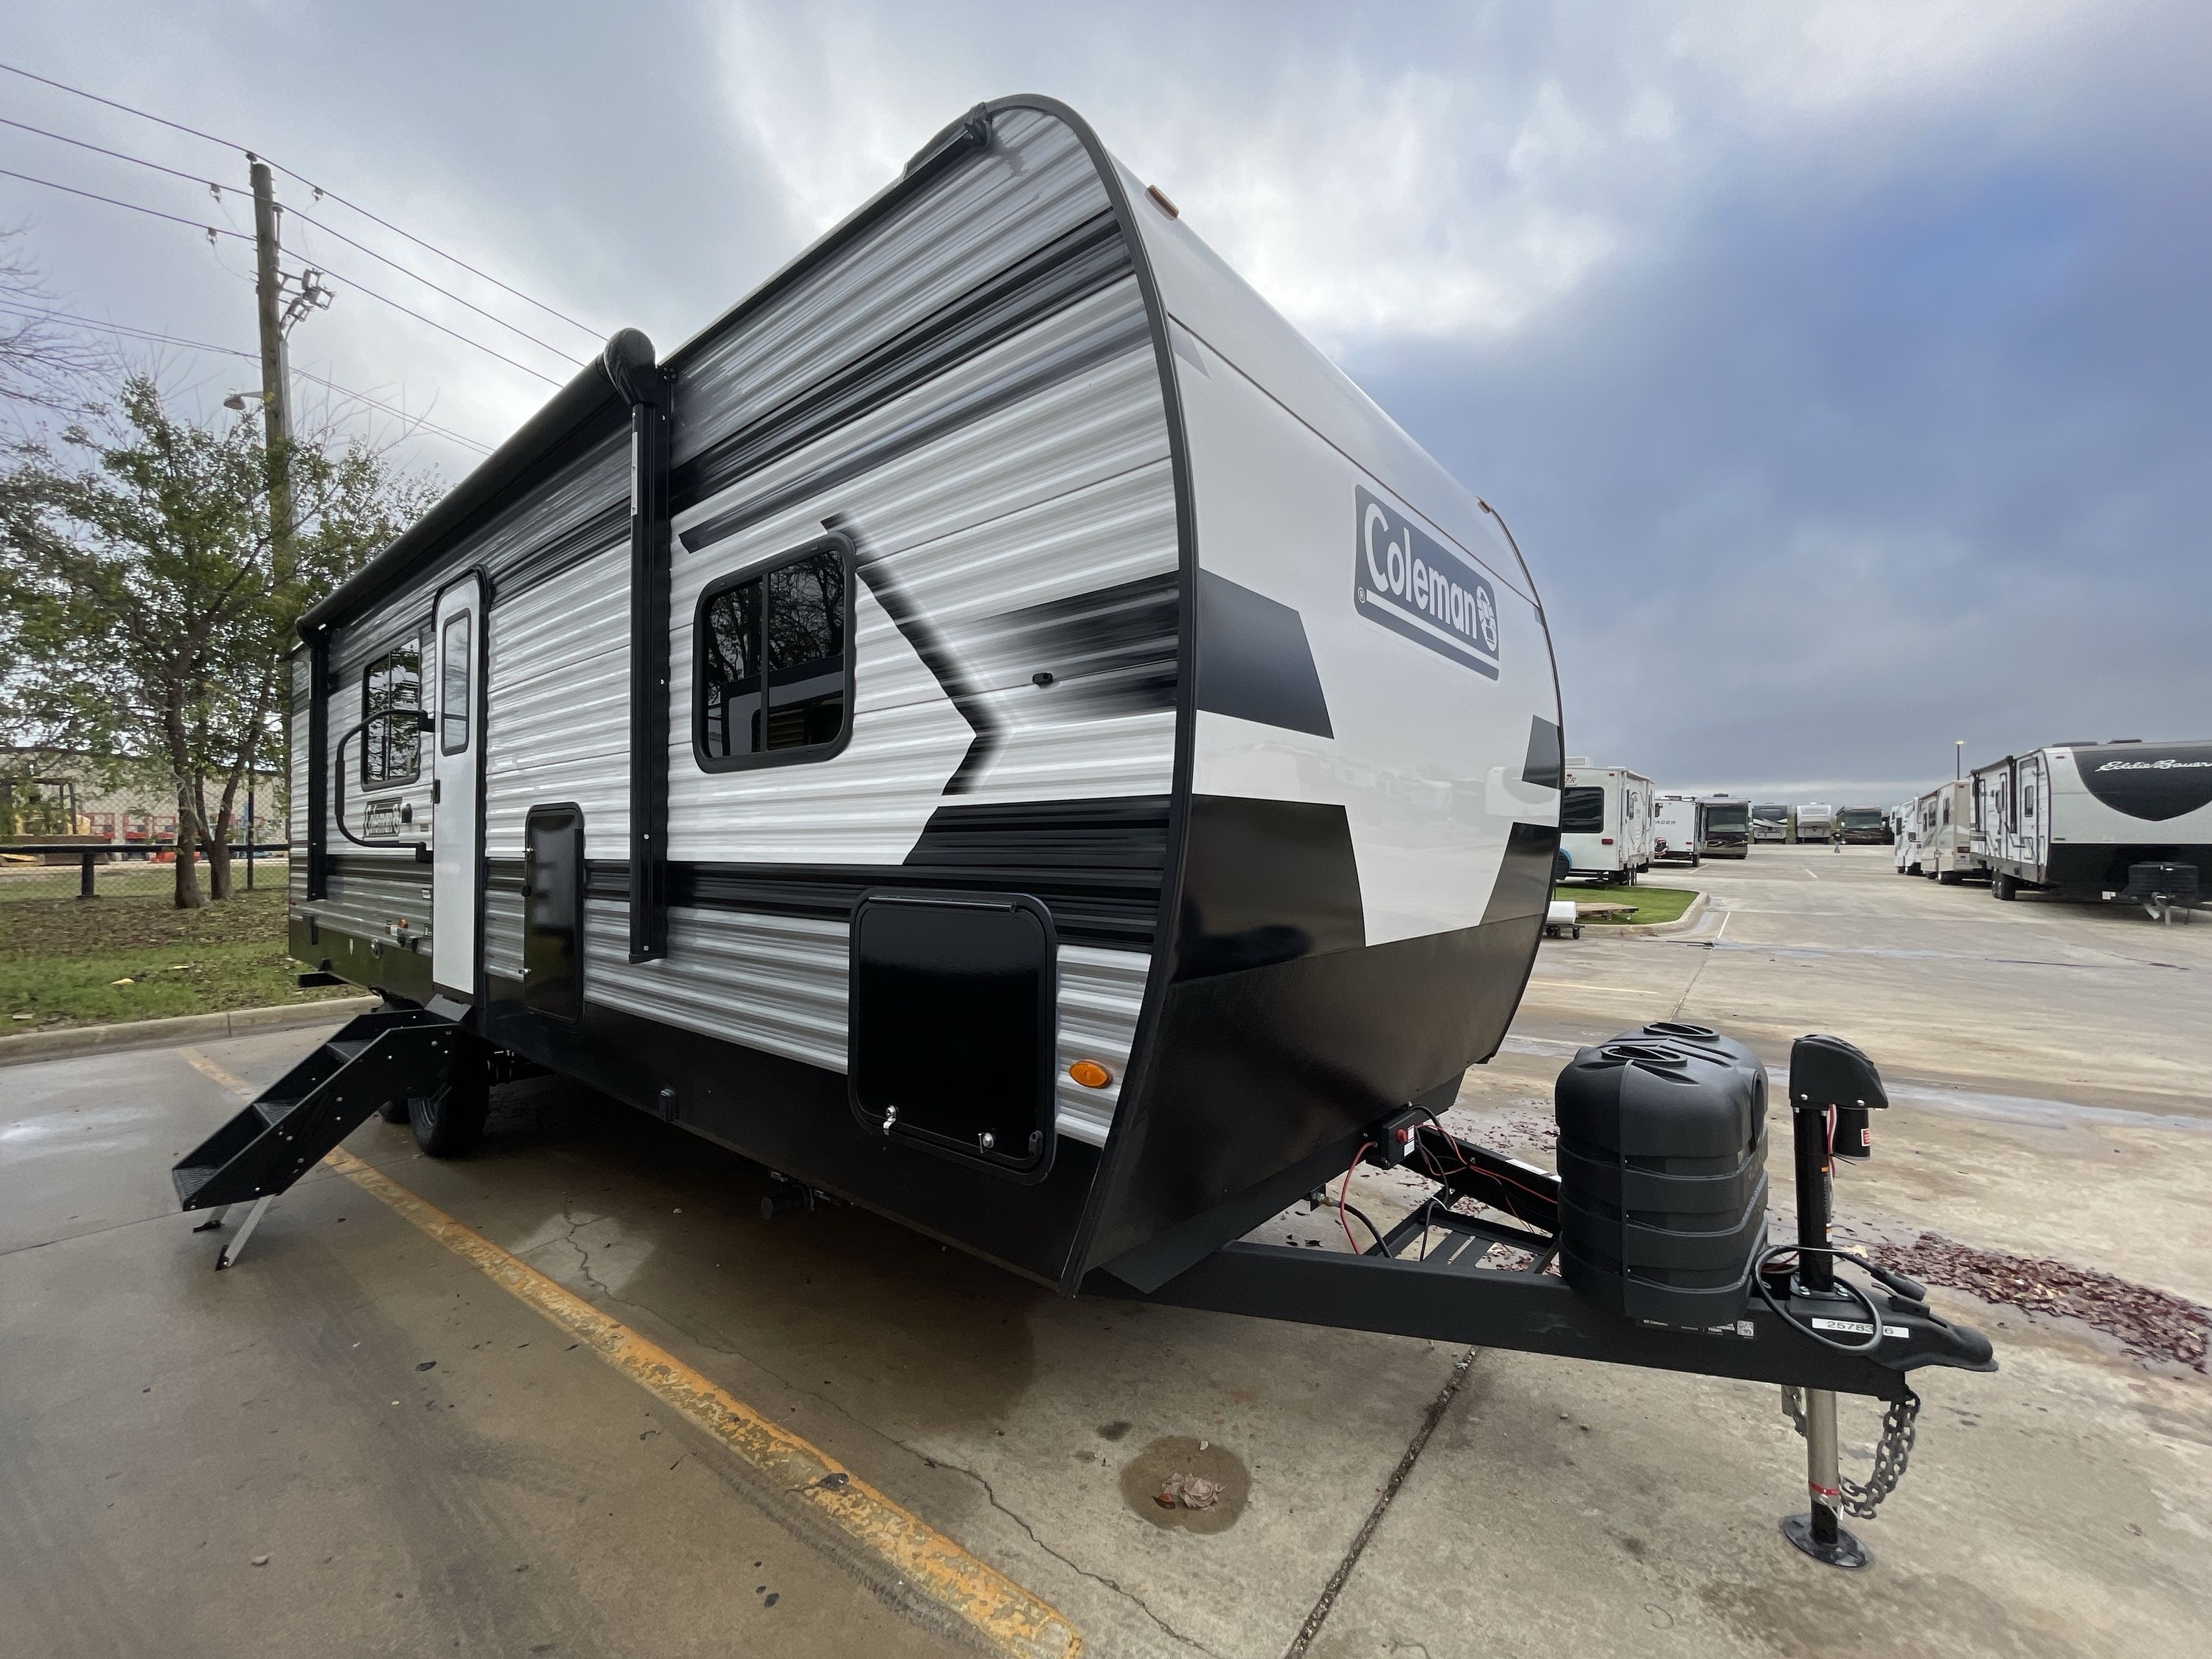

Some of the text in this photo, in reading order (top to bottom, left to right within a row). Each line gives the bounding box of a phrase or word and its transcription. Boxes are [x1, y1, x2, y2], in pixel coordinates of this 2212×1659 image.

[1365, 503, 1478, 639] Coleman
[2094, 759, 2212, 772] Eddie Bauer
